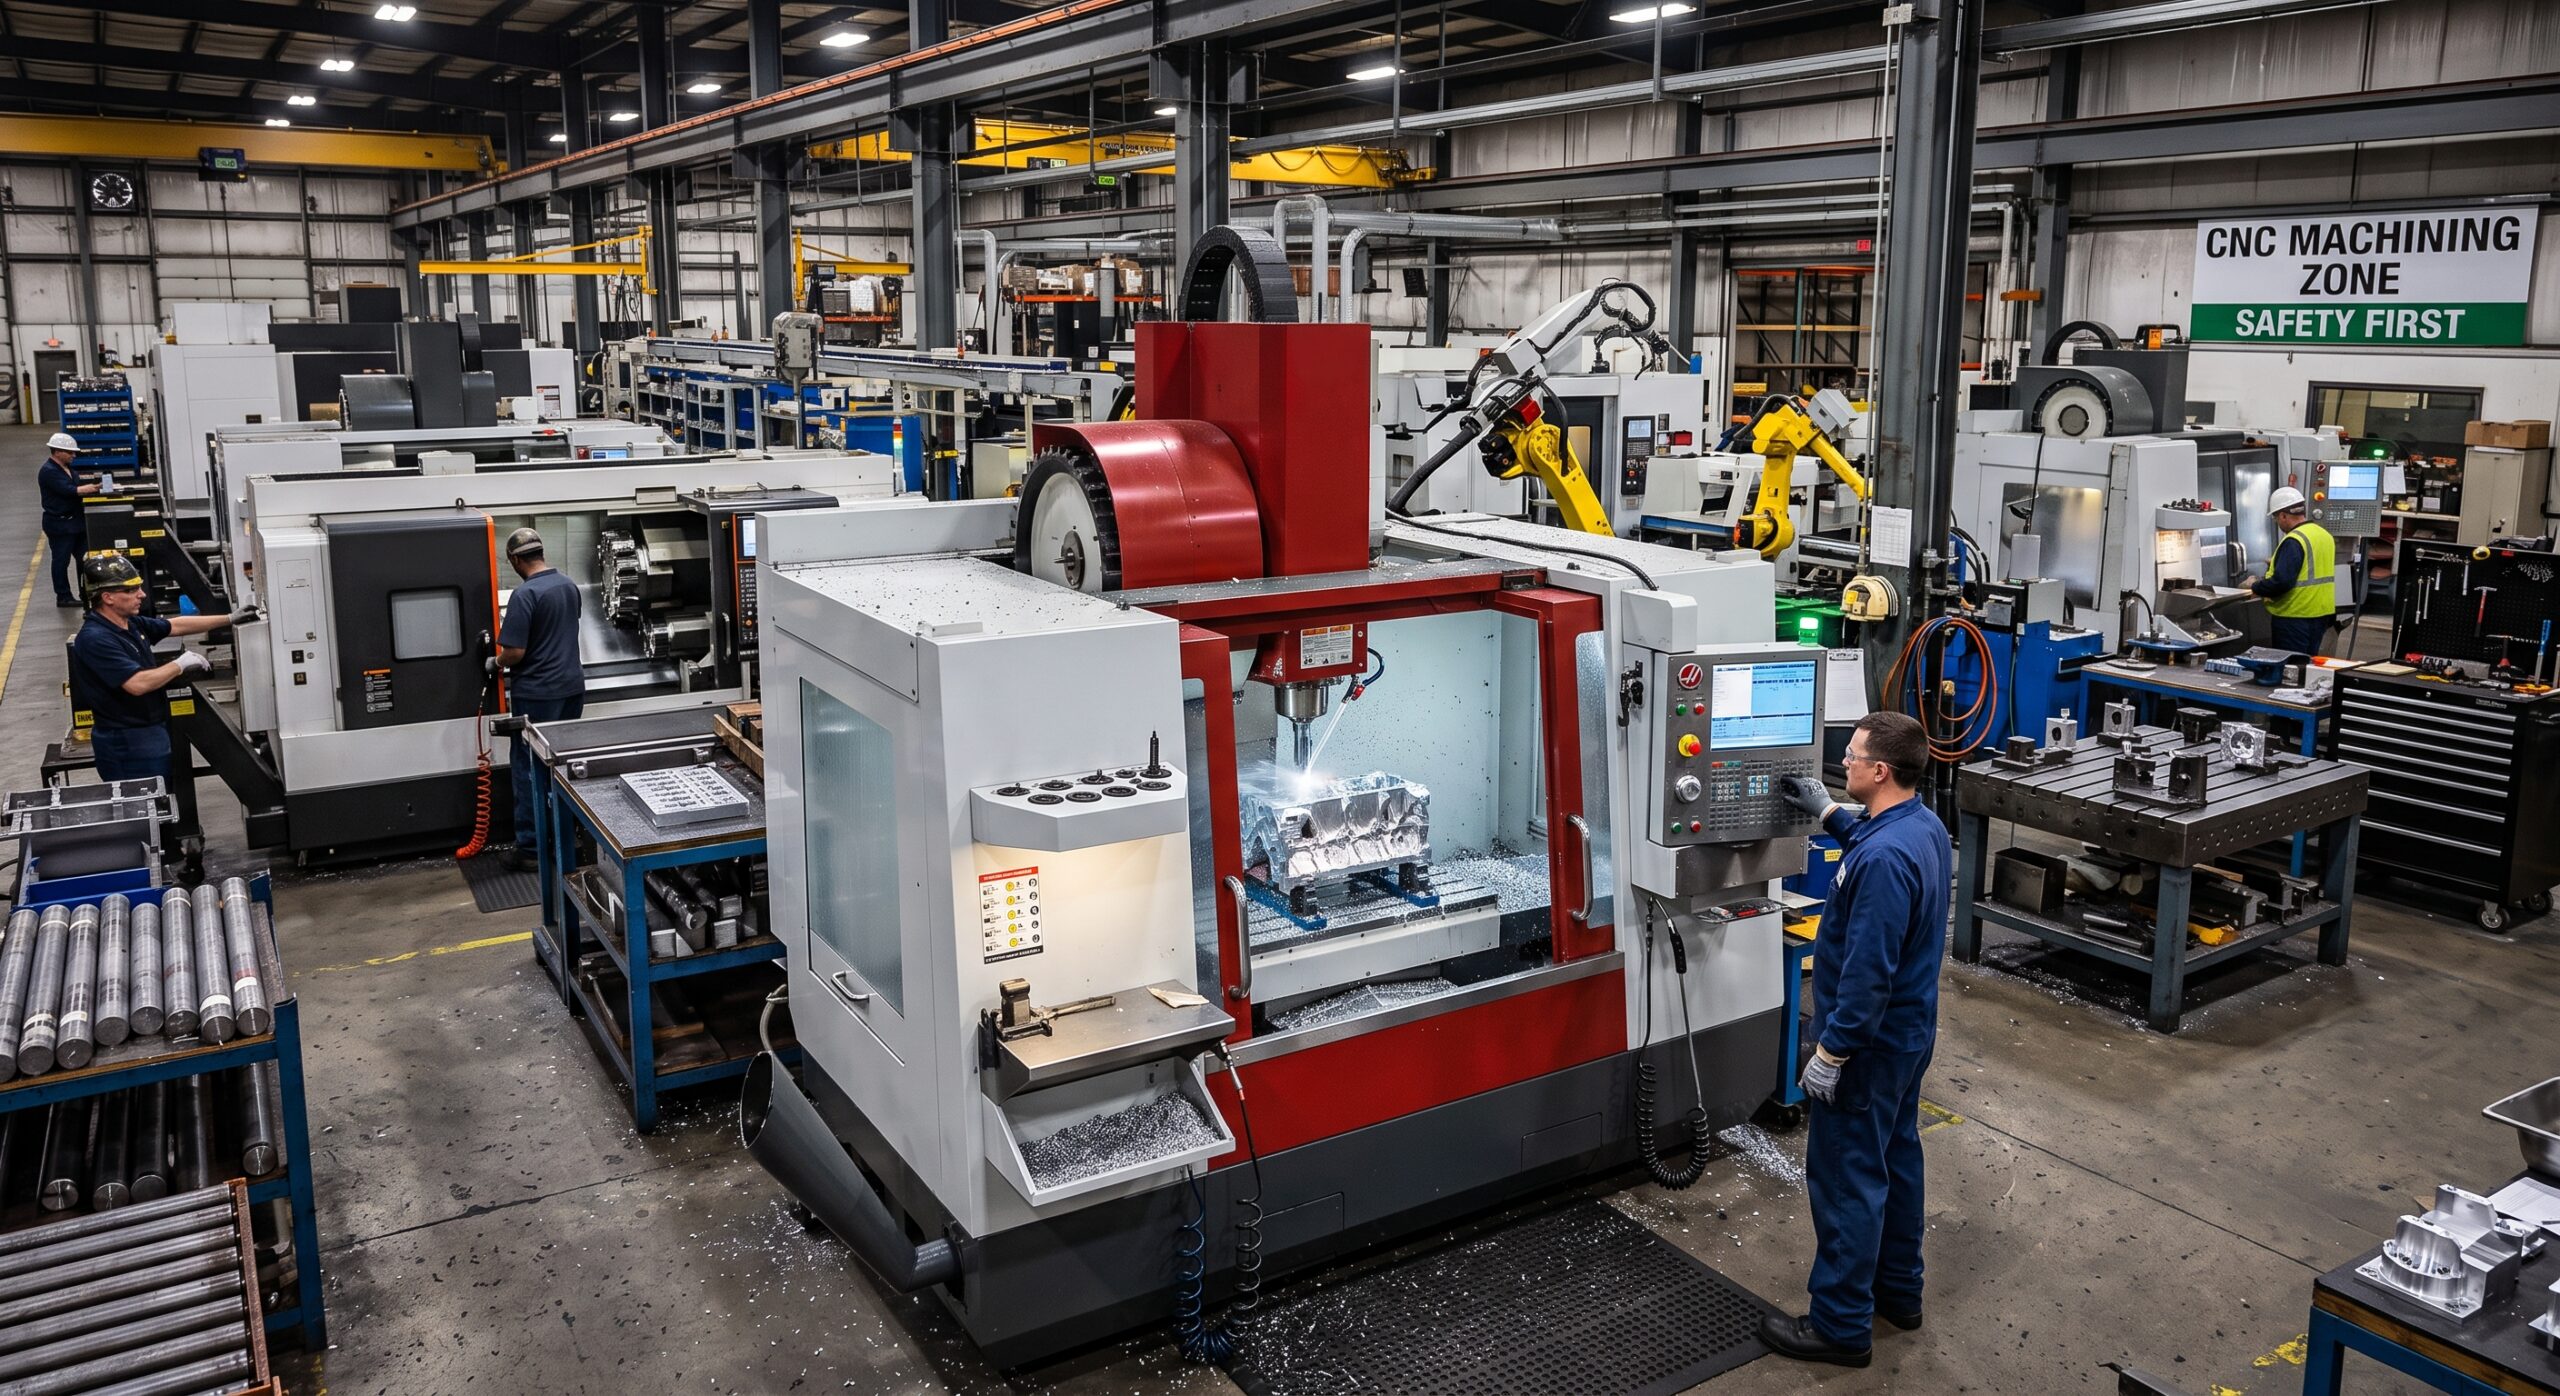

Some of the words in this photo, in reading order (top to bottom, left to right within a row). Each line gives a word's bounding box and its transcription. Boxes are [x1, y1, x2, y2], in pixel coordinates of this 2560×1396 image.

[2206, 226, 2276, 258] CNC
[2289, 216, 2521, 256] MACHINING
[2300, 262, 2401, 295] ZONE
[2235, 309, 2355, 337] SAFETY
[2365, 309, 2465, 339] FIRST
